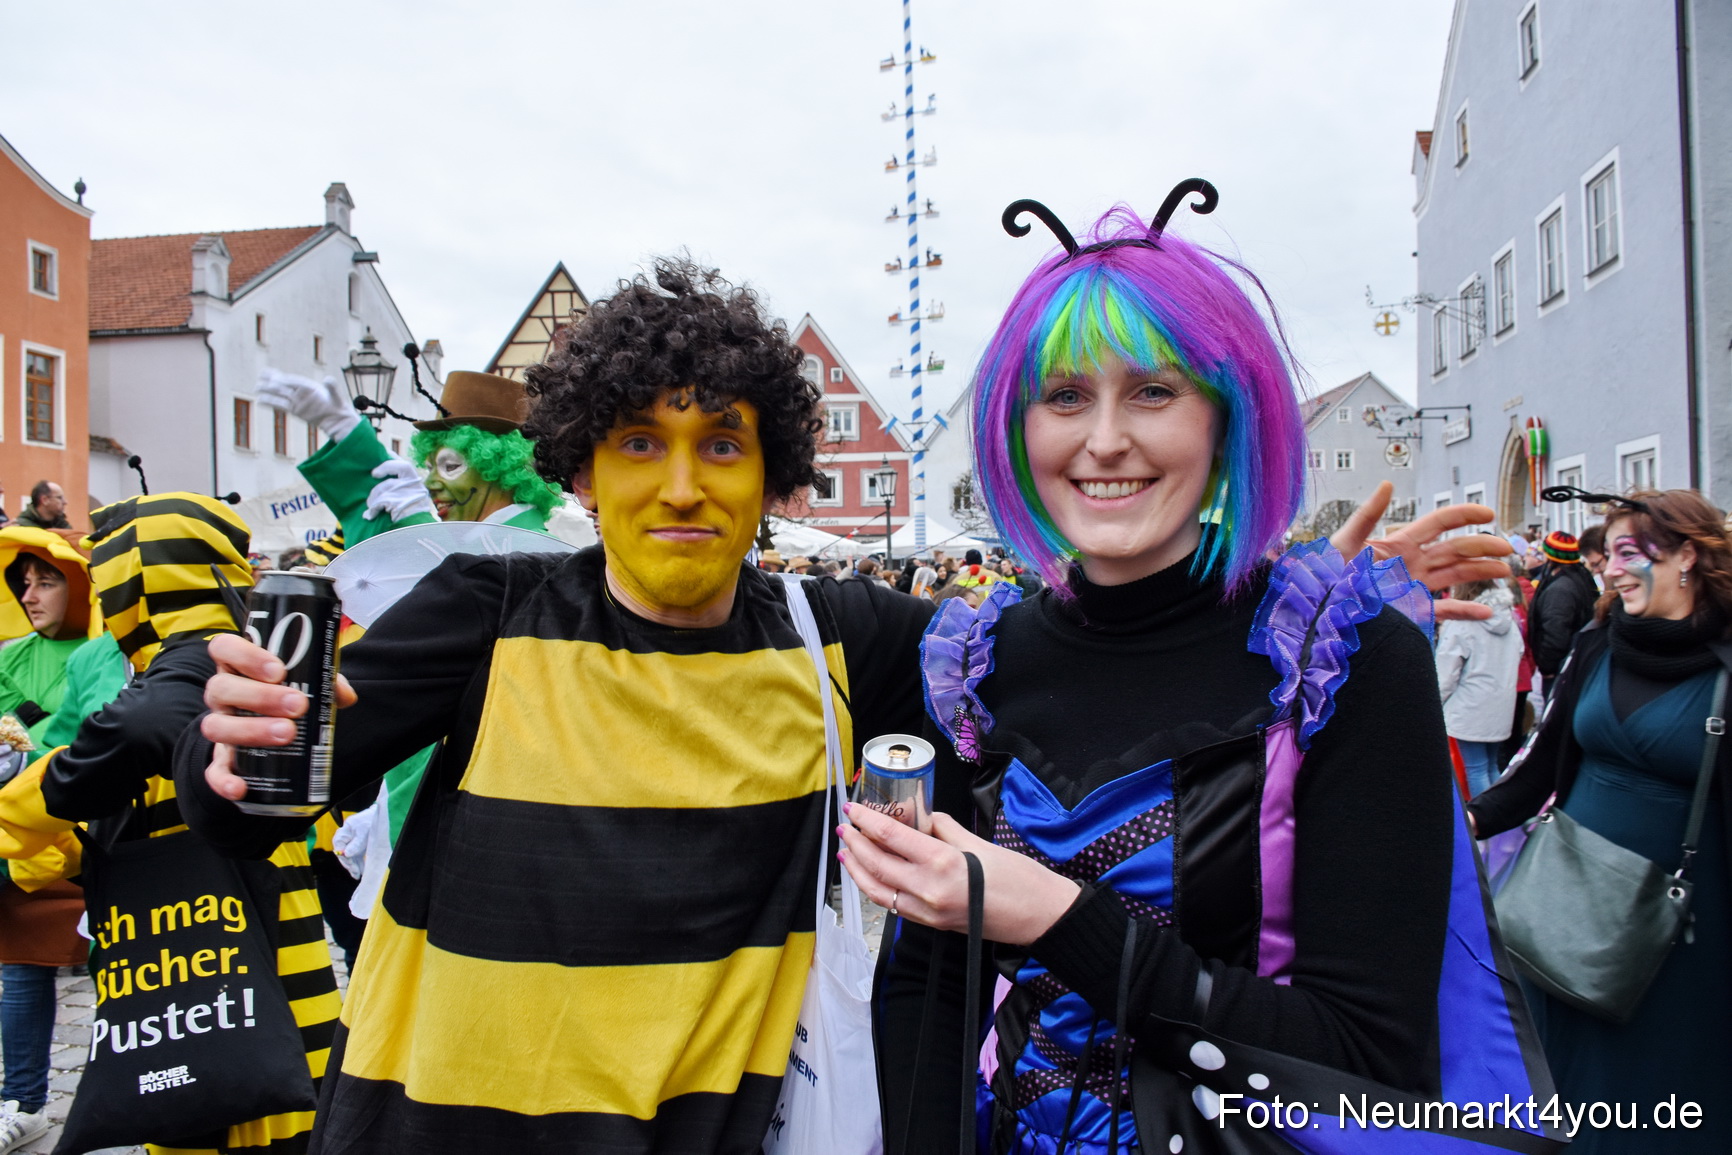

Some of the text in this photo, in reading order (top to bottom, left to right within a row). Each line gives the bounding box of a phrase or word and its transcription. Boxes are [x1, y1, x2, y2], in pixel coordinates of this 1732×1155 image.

[270, 492, 324, 519] Festze
[244, 610, 313, 671] 50
[150, 894, 247, 933] mag
[97, 946, 248, 1007] Bücher.
[89, 988, 256, 1062] Pustet!
[795, 1021, 808, 1043] UB
